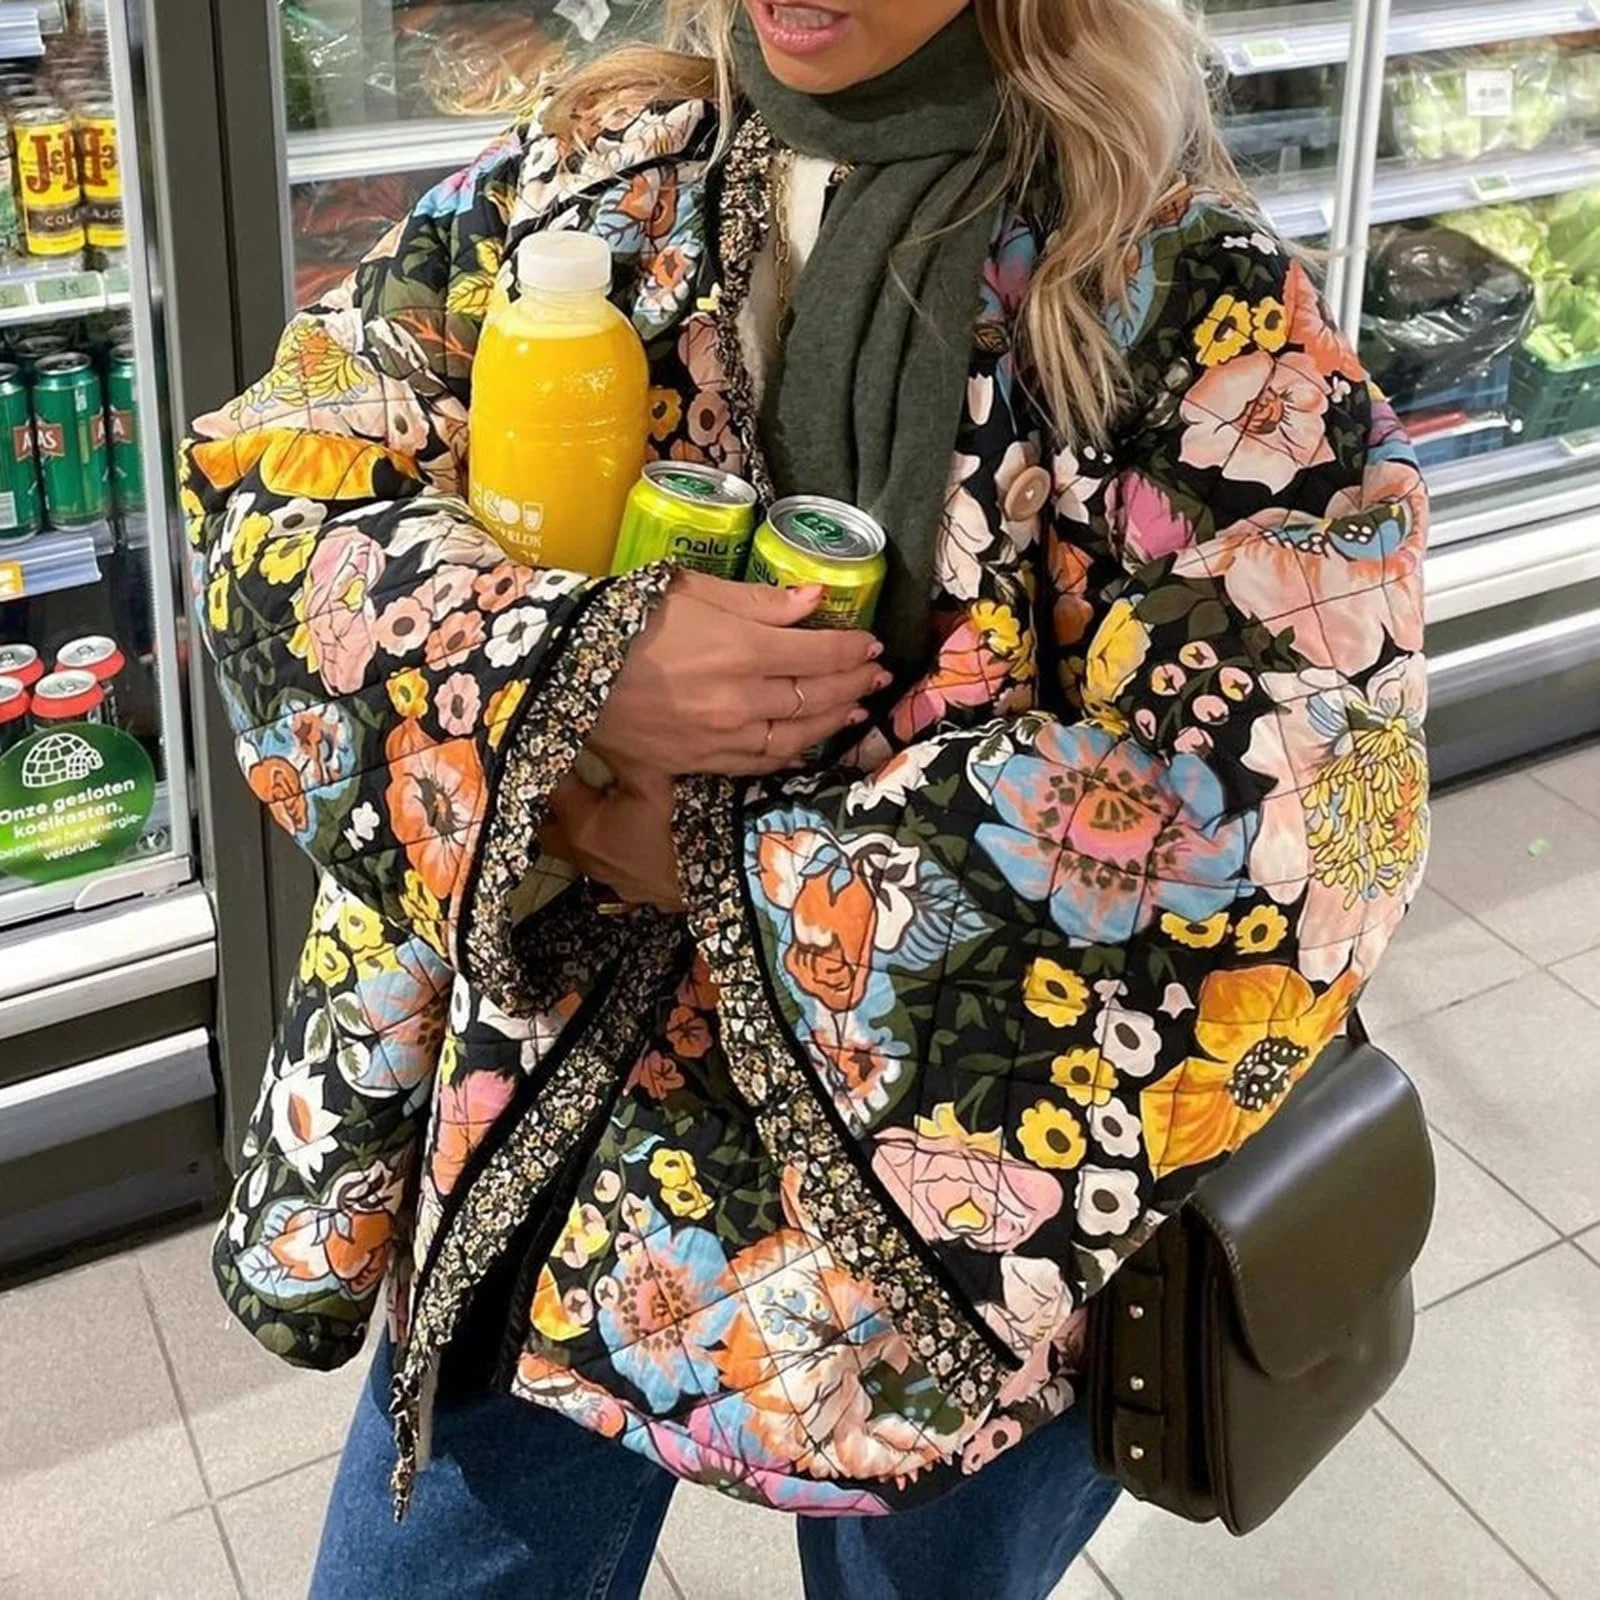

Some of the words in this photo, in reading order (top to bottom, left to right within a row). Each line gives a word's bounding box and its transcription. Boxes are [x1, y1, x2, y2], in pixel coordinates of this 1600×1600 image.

[675, 536, 729, 557] nalu
[0, 803, 48, 824] Onze
[53, 779, 136, 813] gesloten
